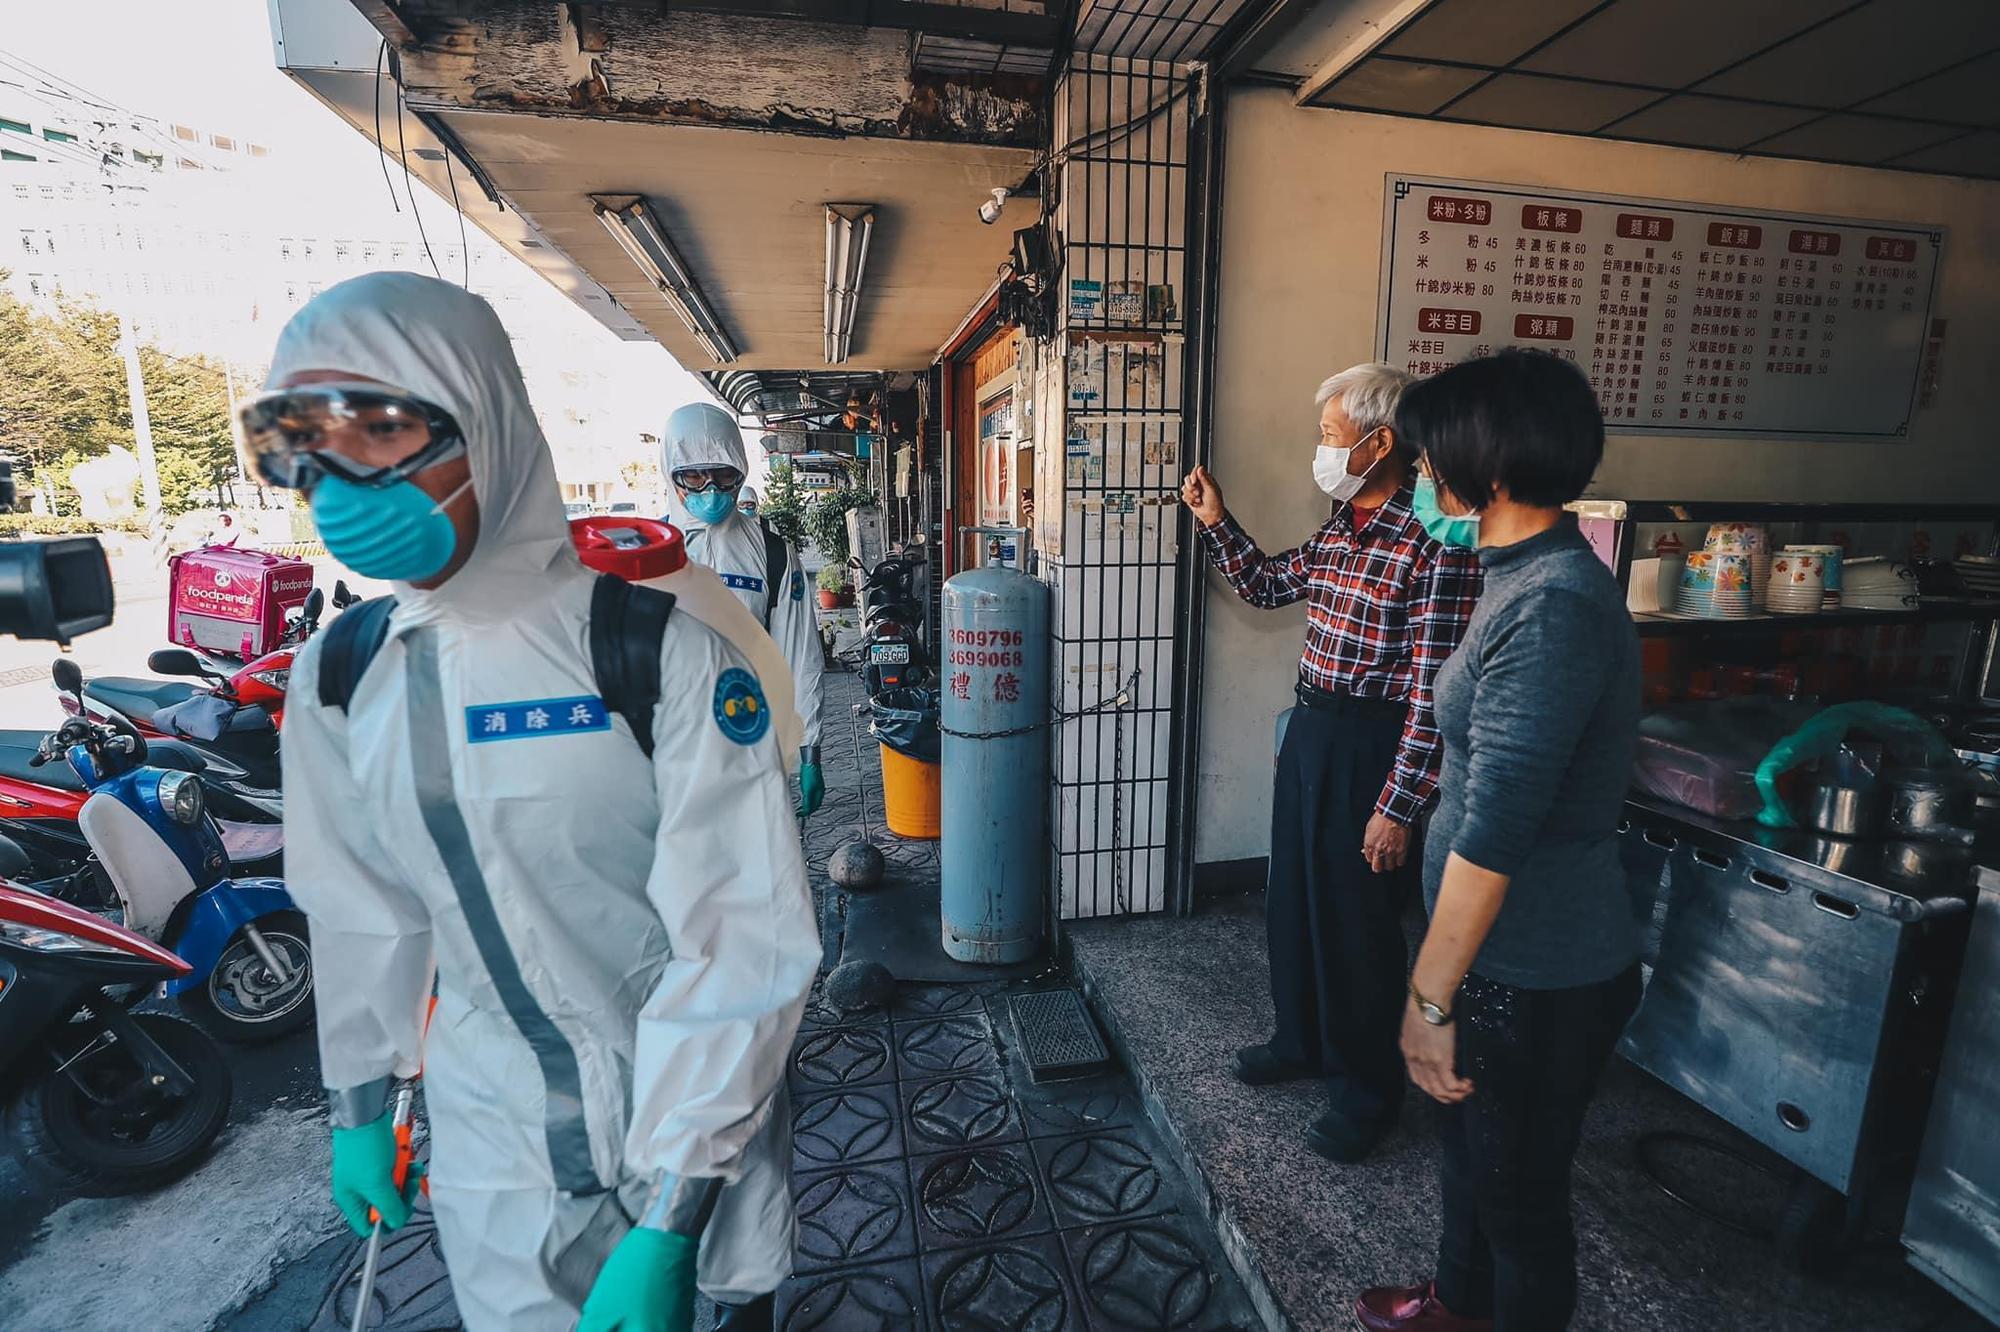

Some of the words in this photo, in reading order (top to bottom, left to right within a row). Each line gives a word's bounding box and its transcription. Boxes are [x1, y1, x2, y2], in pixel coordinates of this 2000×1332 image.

[1486, 237, 1498, 249] 45
[1575, 244, 1586, 254] 60
[1672, 251, 1683, 261] 45
[1484, 261, 1496, 272] 45
[1573, 261, 1584, 271] 80
[1670, 265, 1681, 275] 45
[1416, 279, 1475, 296] 什錦炒米粉
[1482, 285, 1494, 295] 80
[1571, 278, 1583, 288] 80
[1668, 280, 1679, 290] 45
[1570, 295, 1581, 305] 70
[1667, 295, 1677, 304] 50
[1665, 309, 1676, 319] 60
[1428, 313, 1472, 331] 米苔目
[1531, 319, 1557, 336] 粥類
[1664, 324, 1674, 333] 80
[1408, 340, 1444, 354] 米苔目
[1662, 338, 1672, 347] 65
[1565, 350, 1575, 360] 70
[1660, 352, 1670, 362] 65
[1407, 361, 1454, 375] 什錦米
[1658, 367, 1668, 376] 80
[1656, 381, 1666, 390] 90
[1654, 395, 1665, 404] 65
[1652, 409, 1663, 418] 65
[280, 580, 312, 593] foodpanda
[188, 585, 254, 606] foodpanda
[484, 704, 593, 733] 消除兵
